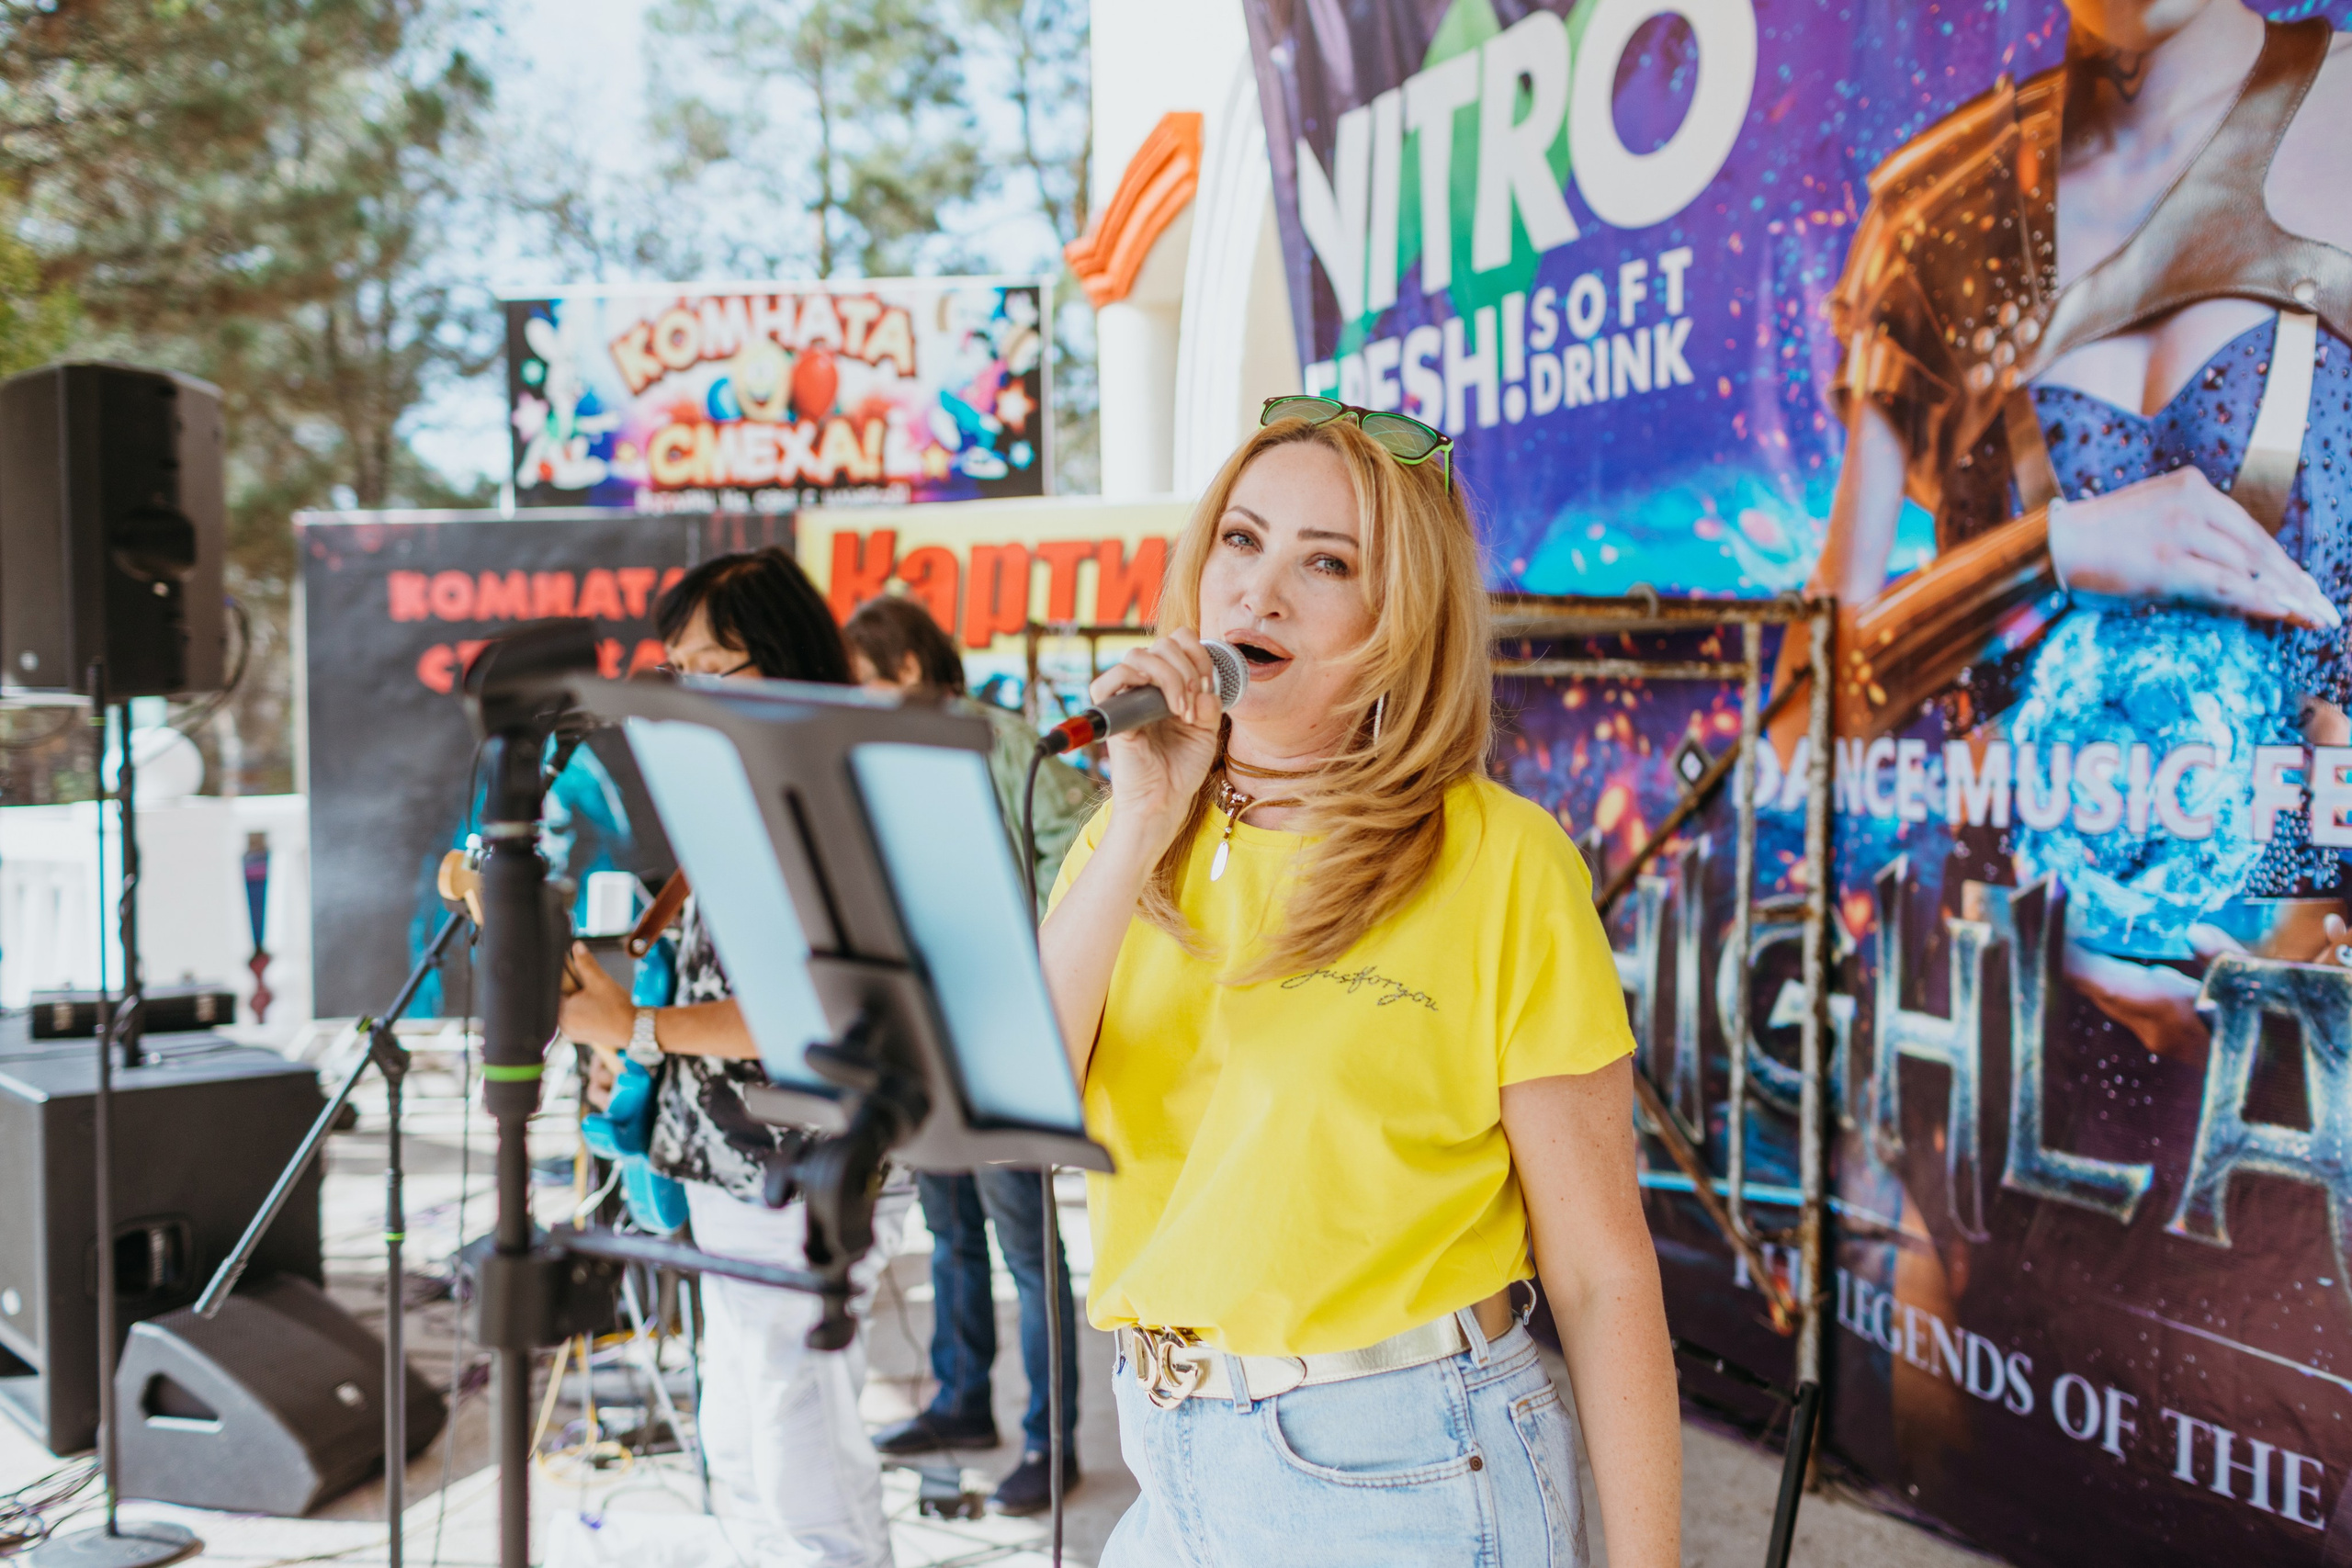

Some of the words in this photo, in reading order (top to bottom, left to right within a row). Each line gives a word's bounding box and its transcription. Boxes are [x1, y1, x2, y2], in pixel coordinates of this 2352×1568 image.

[1296, 0, 1758, 323] NITRO
[611, 292, 918, 395] КОМНАТА
[1531, 246, 1694, 353] SOFT
[1530, 316, 1695, 416] DRINK
[649, 419, 888, 489] СМЕХА!
[830, 528, 1181, 649] Карти
[1732, 737, 1928, 822] DANCE
[1945, 739, 2217, 839] MUSIC
[1836, 1264, 2035, 1416] LEGENDS
[2051, 1372, 2140, 1463] OF
[2160, 1406, 2326, 1531] THE
